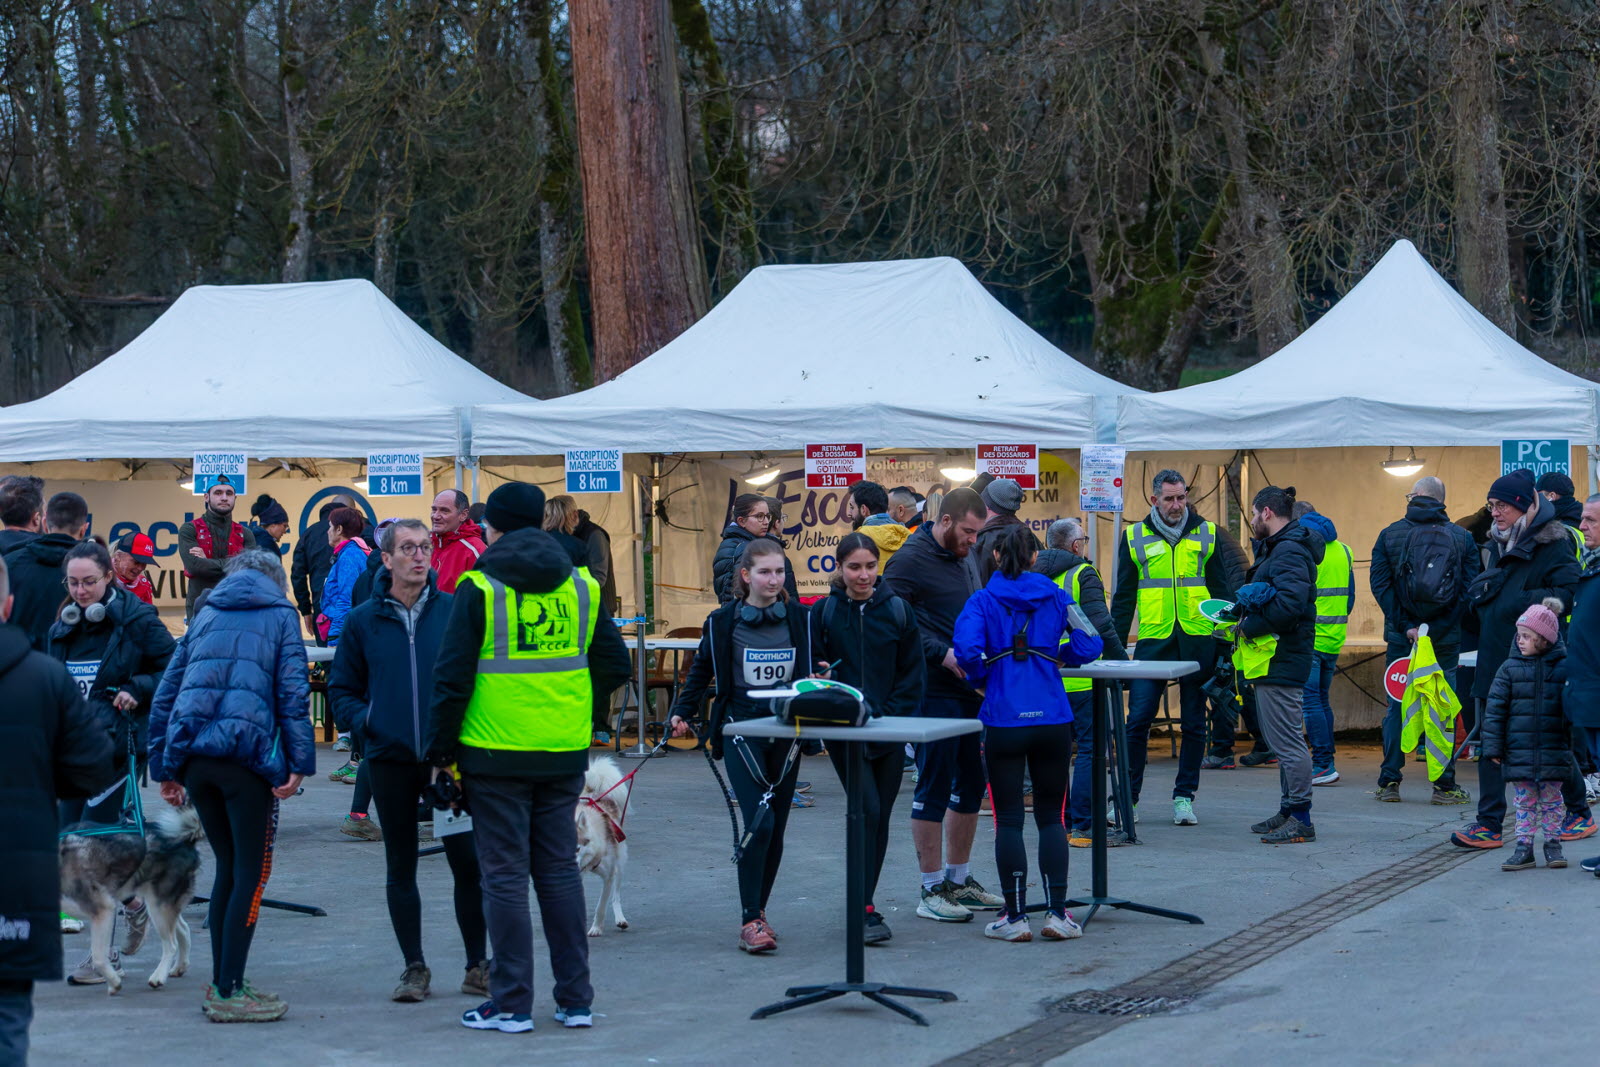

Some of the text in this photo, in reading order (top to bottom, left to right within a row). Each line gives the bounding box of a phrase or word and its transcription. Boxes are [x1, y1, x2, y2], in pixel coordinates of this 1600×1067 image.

[567, 450, 619, 461] INSCRIPTIONS
[1518, 441, 1551, 461] PC
[195, 454, 245, 464] INSCRIPTIONS
[369, 454, 420, 464] INSCRIPTIONS
[200, 463, 239, 474] COUREURS
[569, 460, 617, 471] MARCHEURS
[817, 465, 853, 473] GOTIMING
[988, 466, 1026, 474] GOTIMING
[380, 476, 408, 493] 8 km
[579, 472, 608, 490] 8 km
[822, 474, 848, 486] 13 km
[1033, 489, 1059, 503] KM
[749, 651, 791, 661] DECATHLON
[753, 664, 786, 680] 190
